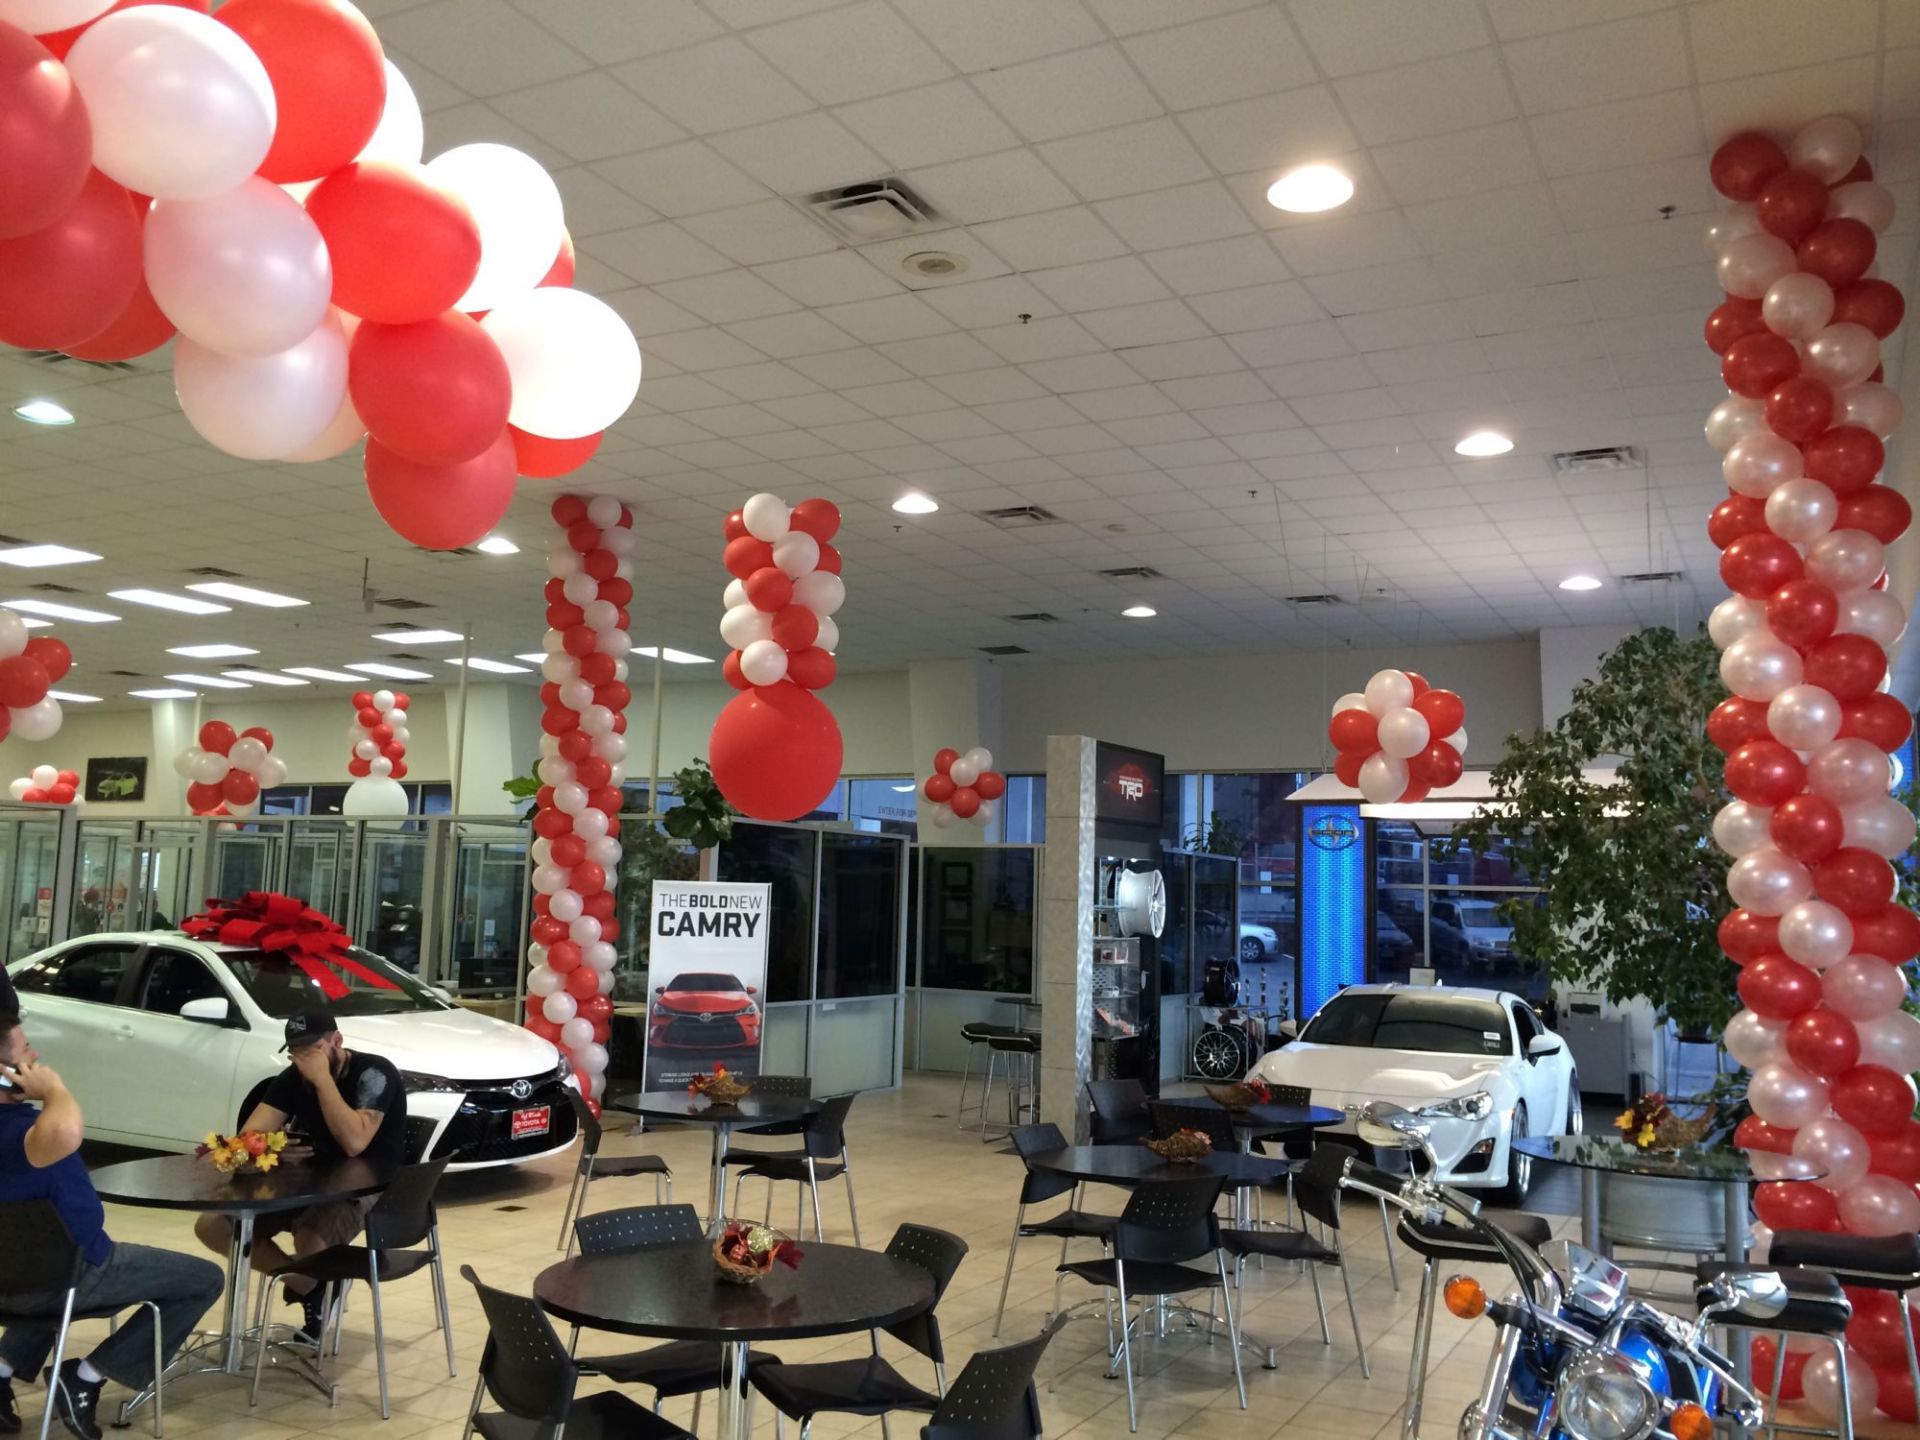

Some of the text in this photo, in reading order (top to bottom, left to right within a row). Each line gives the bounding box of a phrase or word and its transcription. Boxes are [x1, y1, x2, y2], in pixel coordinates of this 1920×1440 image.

[1118, 779, 1143, 801] TRD
[658, 910, 762, 938] CAMRY
[520, 1118, 540, 1127] TOYOTA
